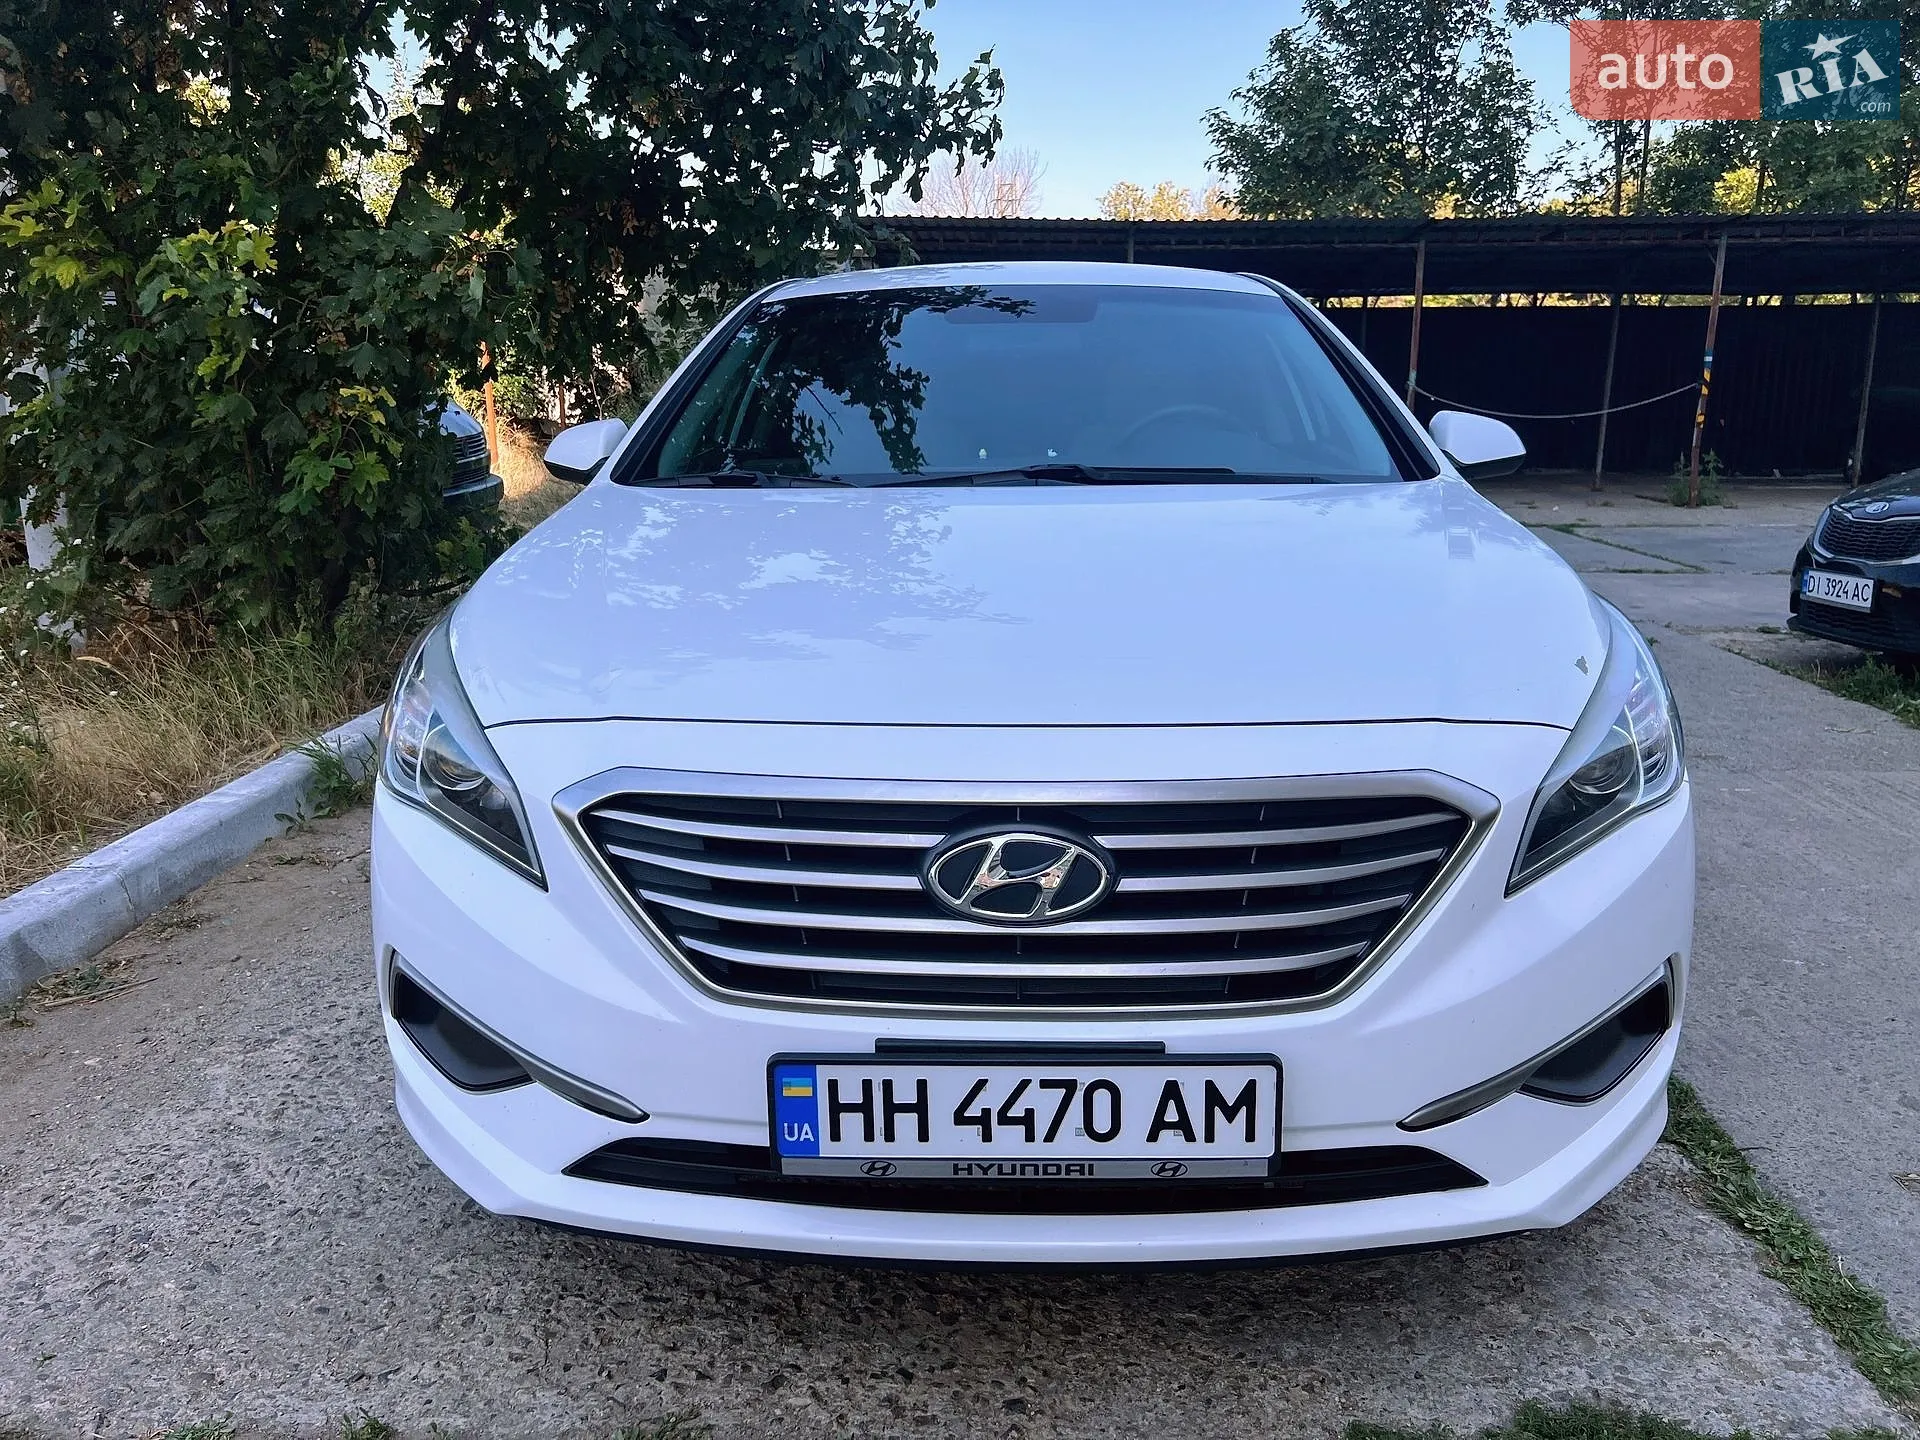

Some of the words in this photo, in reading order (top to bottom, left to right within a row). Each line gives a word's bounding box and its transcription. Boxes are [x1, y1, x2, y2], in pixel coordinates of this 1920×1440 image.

[1807, 575, 1821, 594] DI
[1824, 578, 1850, 600] 3924
[1851, 582, 1871, 602] AC
[826, 1078, 930, 1143] HH
[952, 1078, 1122, 1143] 4470
[1145, 1078, 1257, 1144] AM
[783, 1122, 815, 1142] UA
[952, 1162, 1095, 1177] HYUNDAI
